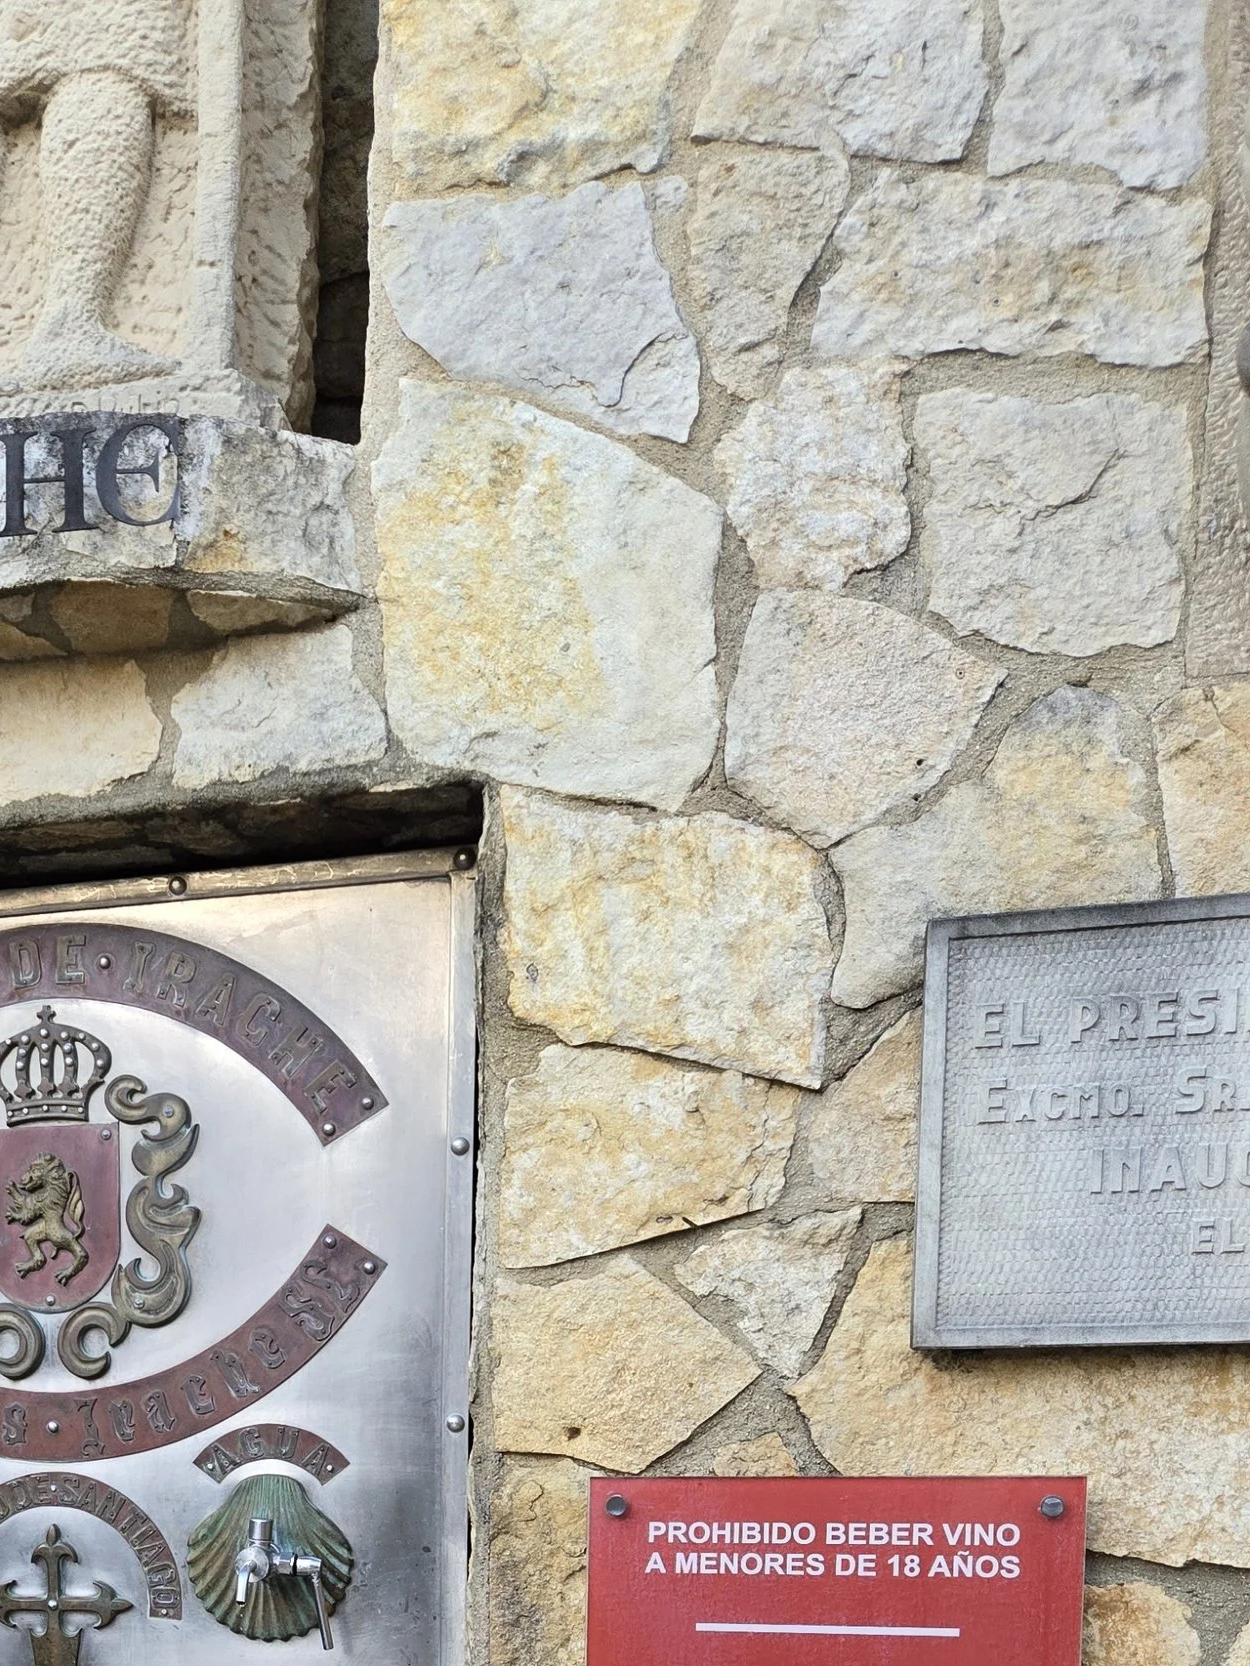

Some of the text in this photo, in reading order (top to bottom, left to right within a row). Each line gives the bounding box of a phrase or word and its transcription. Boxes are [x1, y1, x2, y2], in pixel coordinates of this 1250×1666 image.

[9, 934, 87, 990] DE
[122, 940, 358, 1114] IRACHE
[974, 985, 1250, 1050] EL PRESI
[1191, 1216, 1245, 1256] EL
[77, 1326, 287, 1457] Irache
[212, 1427, 330, 1477] AGUA
[8, 1473, 51, 1512] DE
[58, 1475, 180, 1608] SANTIAGO
[648, 1521, 1021, 1546] PROHIBIDO BEBER VINO
[645, 1550, 1021, 1578] A MENORES DE 18 AÑOS
